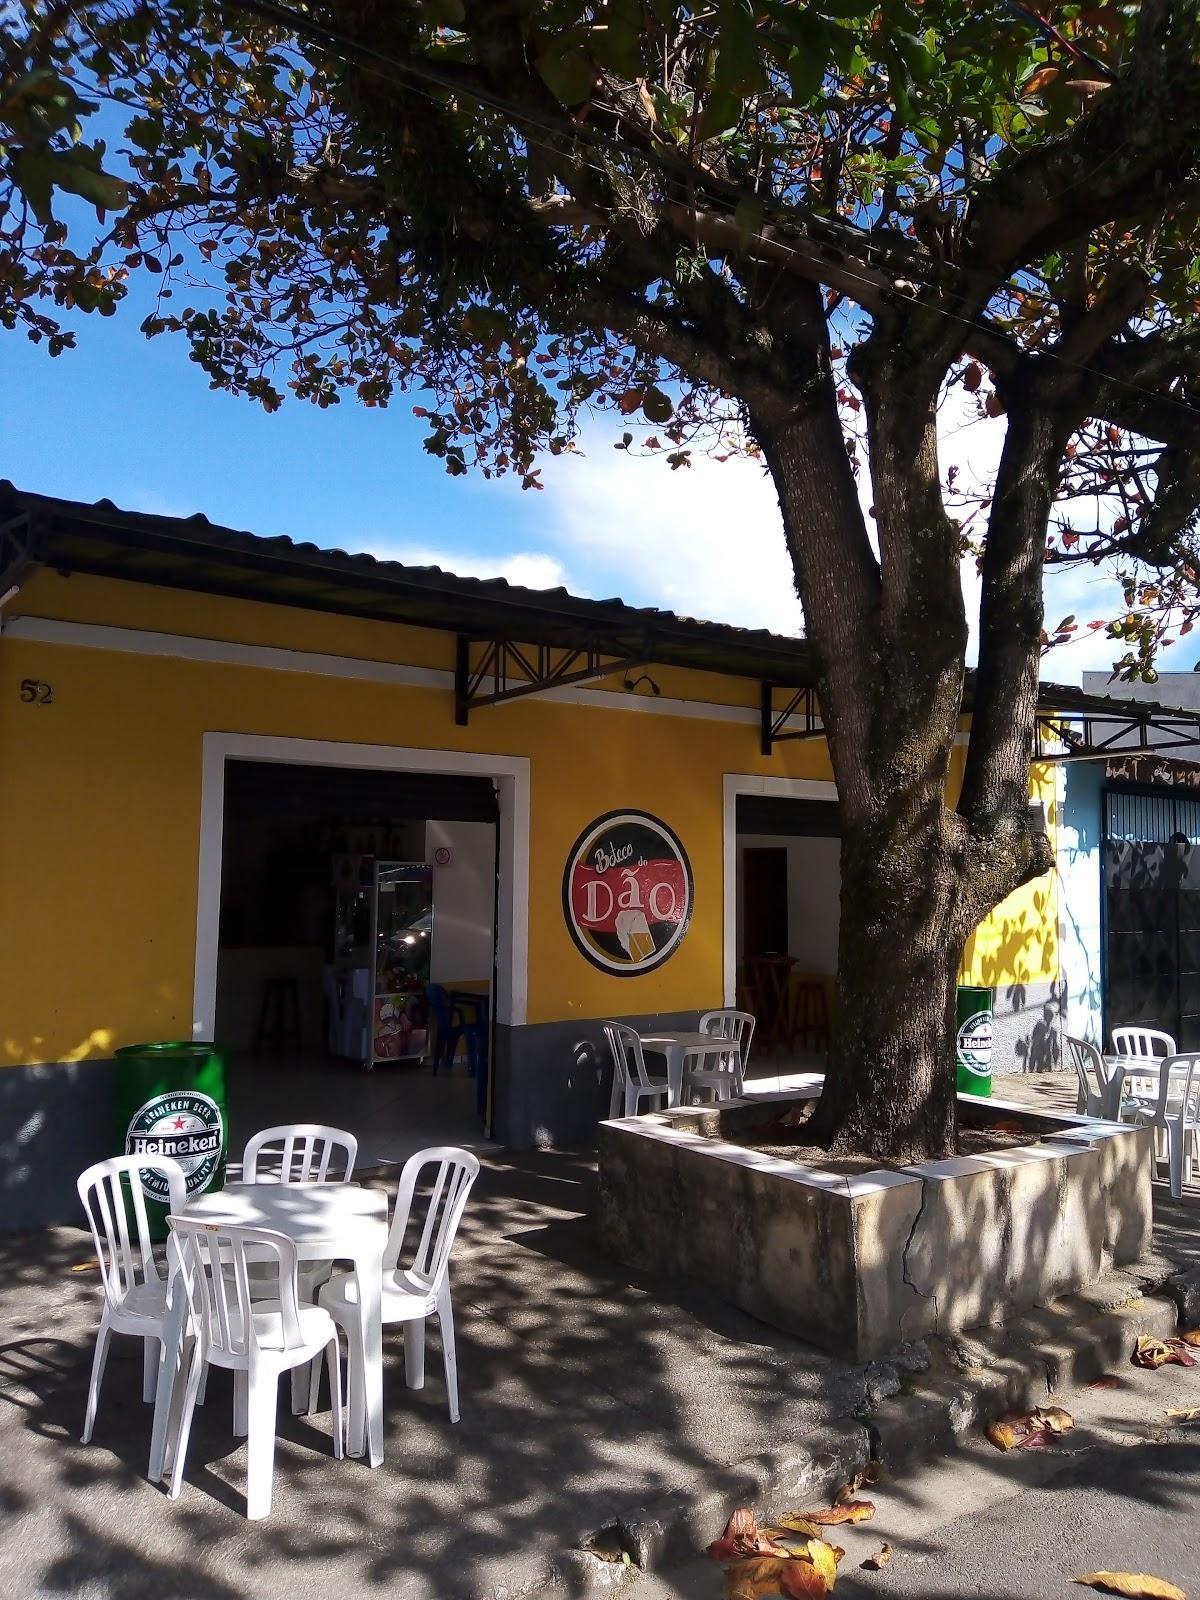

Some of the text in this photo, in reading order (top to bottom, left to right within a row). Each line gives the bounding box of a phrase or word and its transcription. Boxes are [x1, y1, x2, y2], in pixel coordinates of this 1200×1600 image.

[20, 679, 53, 704] 52
[594, 841, 648, 874] Boteco do
[144, 1100, 212, 1125] HEINEKEN BEER
[133, 1133, 218, 1156] Heineken
[139, 1168, 169, 1192] PREMIU
[187, 1160, 212, 1188] UALITY
